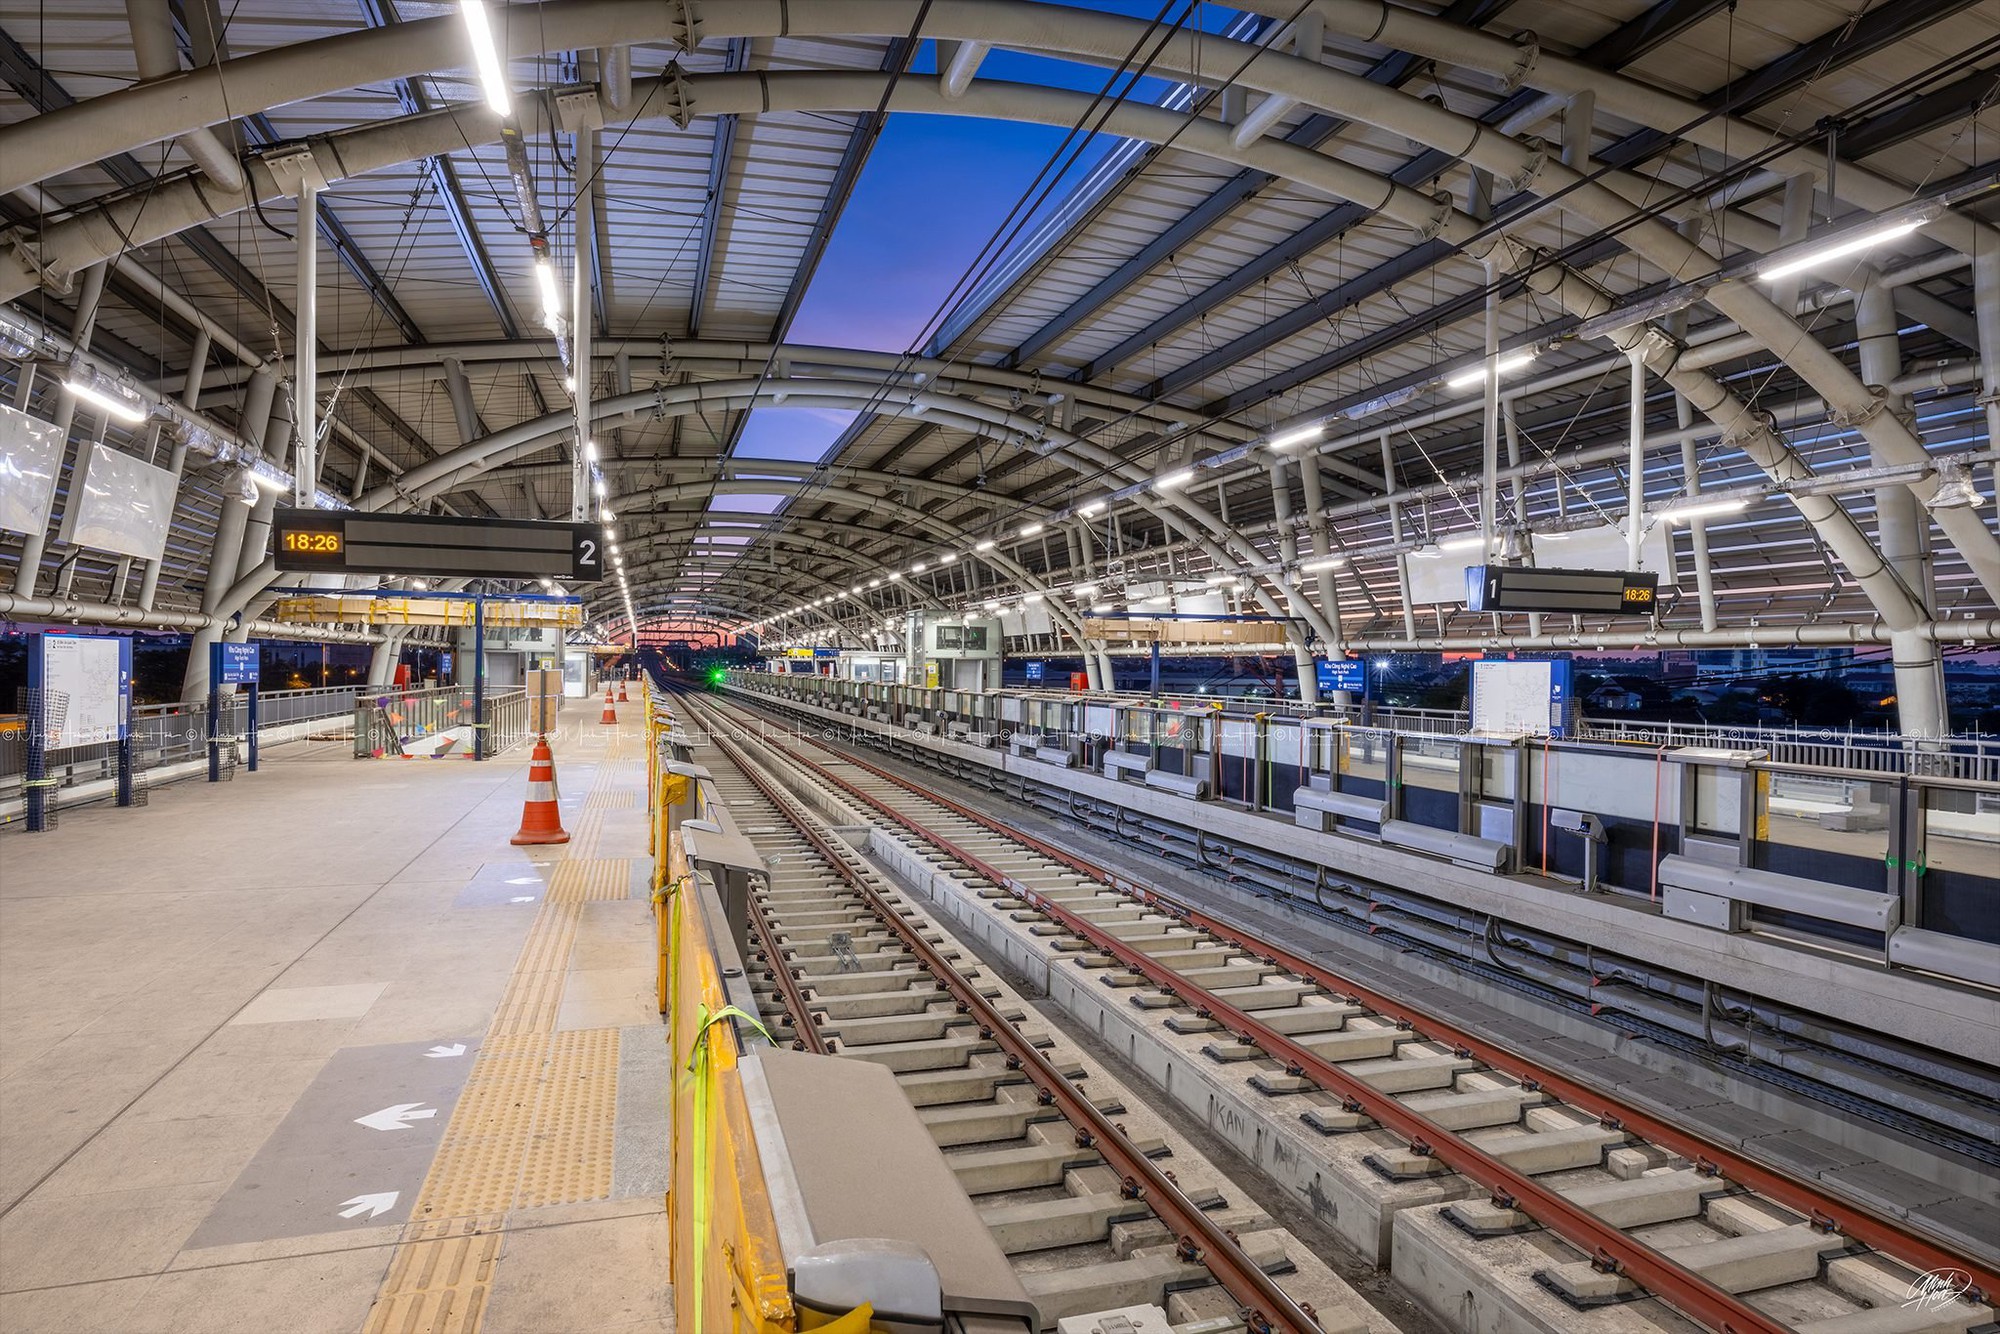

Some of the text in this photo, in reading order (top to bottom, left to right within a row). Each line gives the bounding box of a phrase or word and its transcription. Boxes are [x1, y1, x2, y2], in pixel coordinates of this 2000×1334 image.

[286, 533, 338, 552] 18:26
[579, 539, 597, 565] 2
[1489, 578, 1497, 599] 1
[1625, 589, 1651, 602] 18:26
